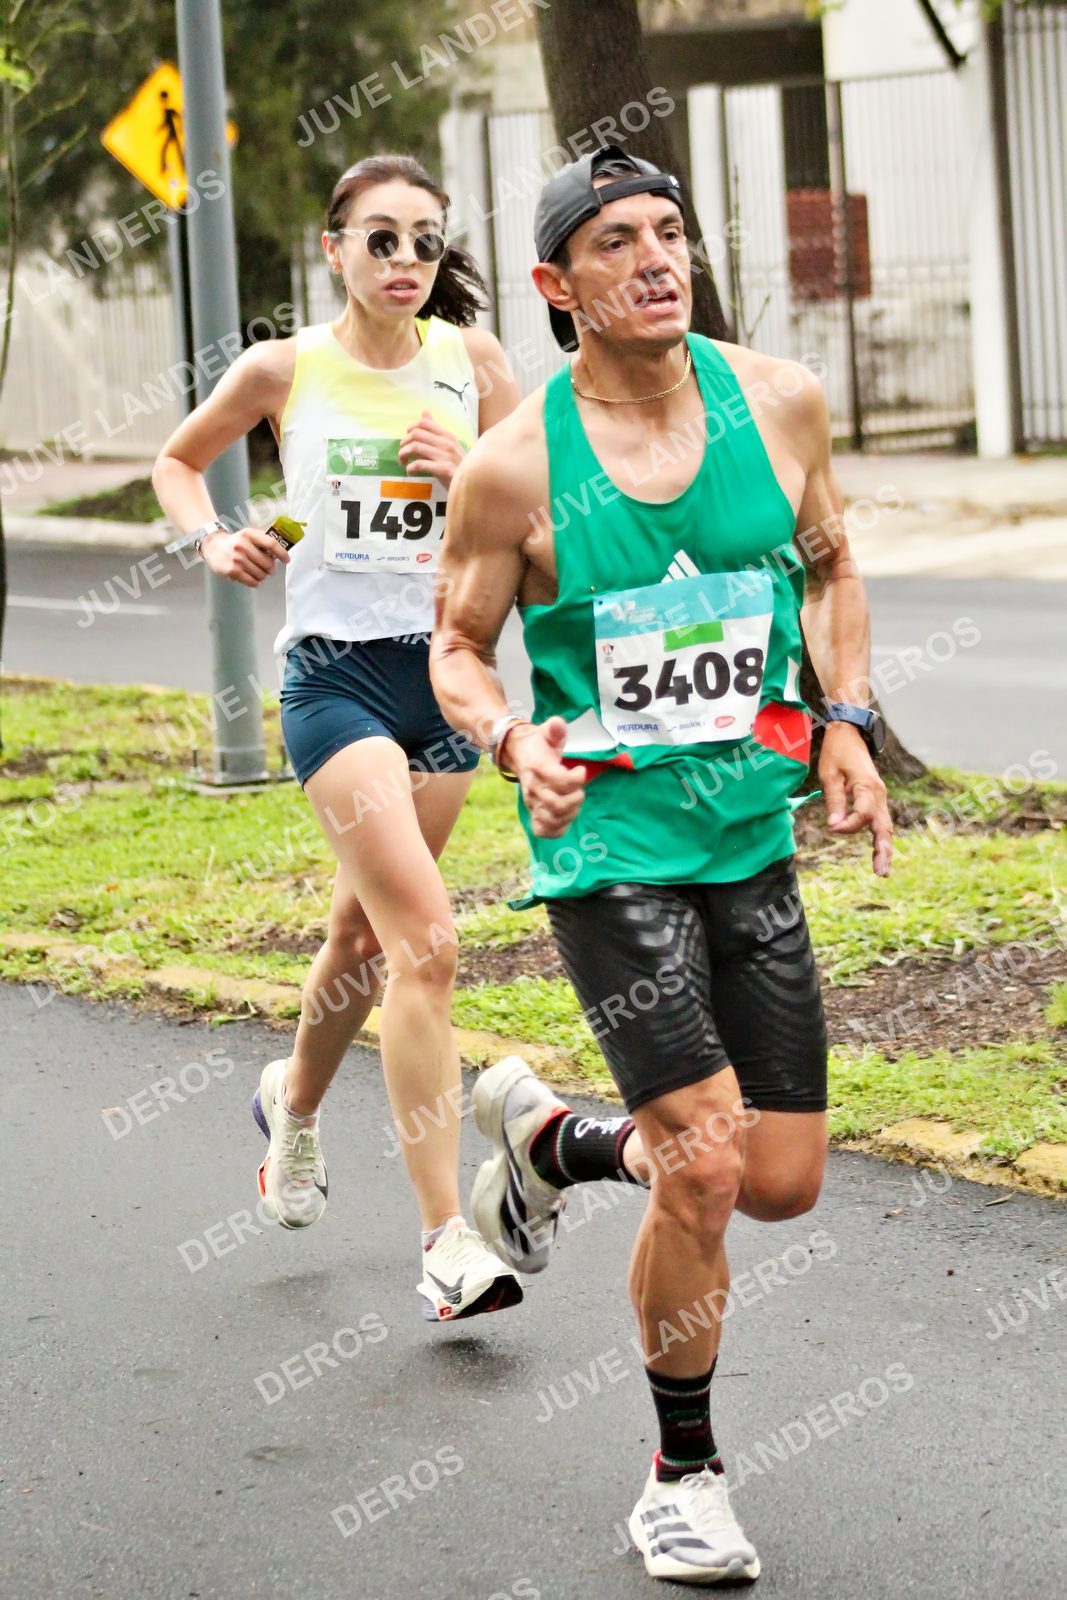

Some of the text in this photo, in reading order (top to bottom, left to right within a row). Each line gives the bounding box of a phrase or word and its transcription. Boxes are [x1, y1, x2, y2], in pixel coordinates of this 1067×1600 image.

[335, 552, 370, 561] PERDURA
[613, 647, 764, 712] 3408
[616, 722, 659, 733] PERDURA
